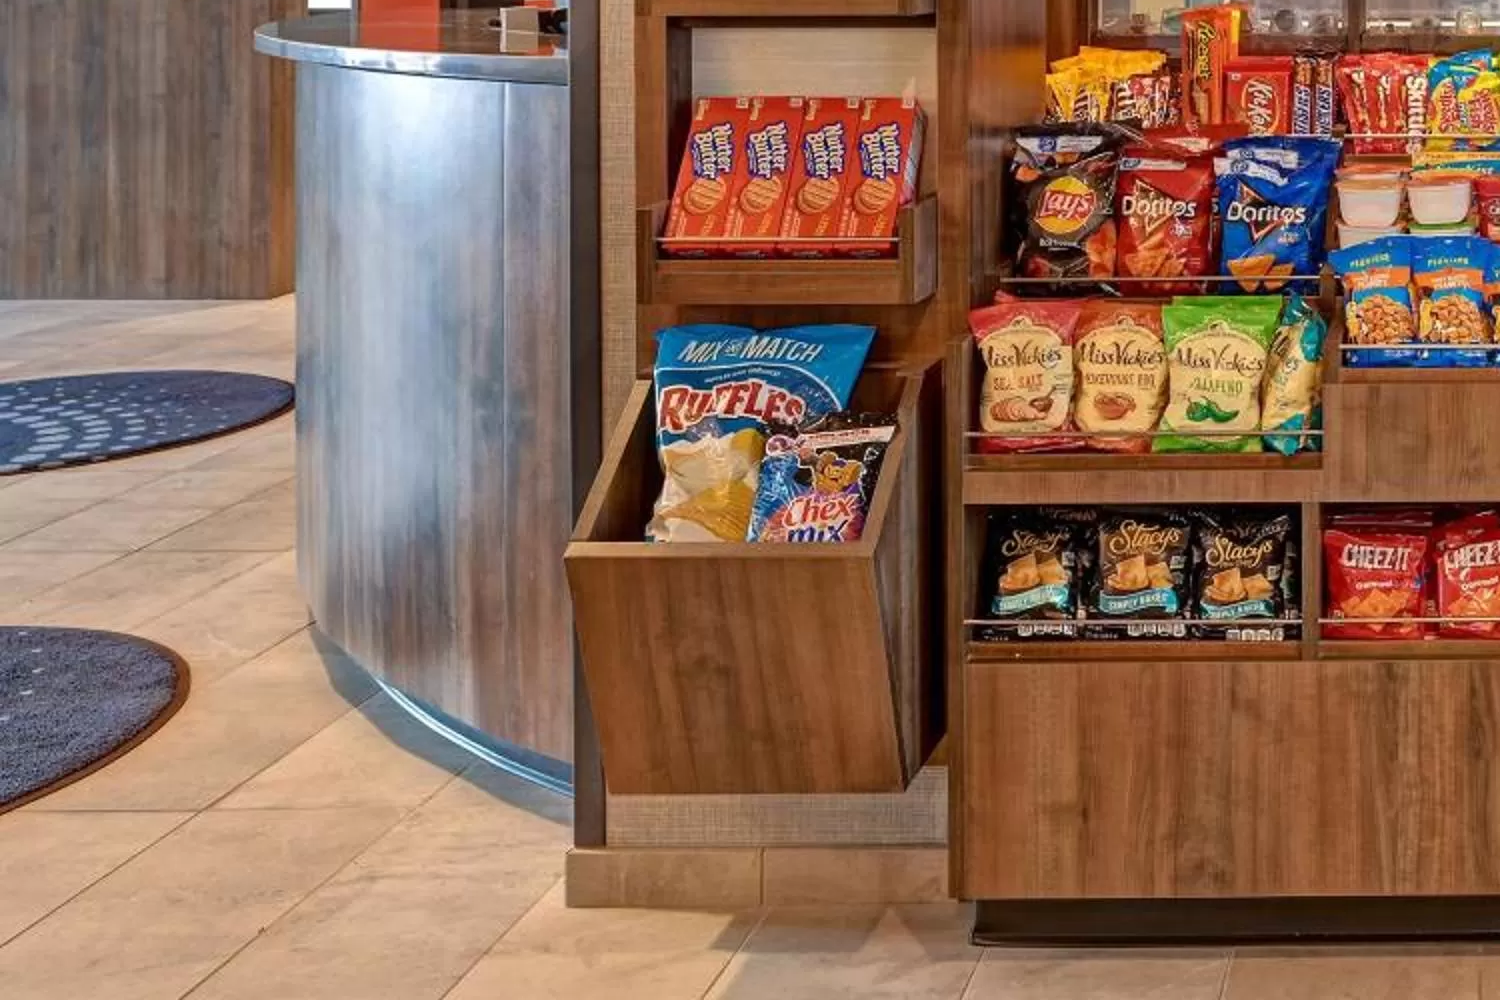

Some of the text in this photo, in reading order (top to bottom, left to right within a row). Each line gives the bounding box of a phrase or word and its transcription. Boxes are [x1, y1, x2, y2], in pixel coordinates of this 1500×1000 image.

[1040, 190, 1095, 222] Lay's
[1122, 195, 1196, 218] Doritos
[1227, 201, 1307, 224] Doritos
[678, 339, 727, 363] MIX
[740, 335, 824, 361] MATCH
[661, 378, 806, 432] RUFFLES
[785, 498, 856, 525] Chex
[787, 521, 850, 542] mix
[1109, 519, 1180, 555] Stacy's
[1206, 534, 1273, 567] Stacy's
